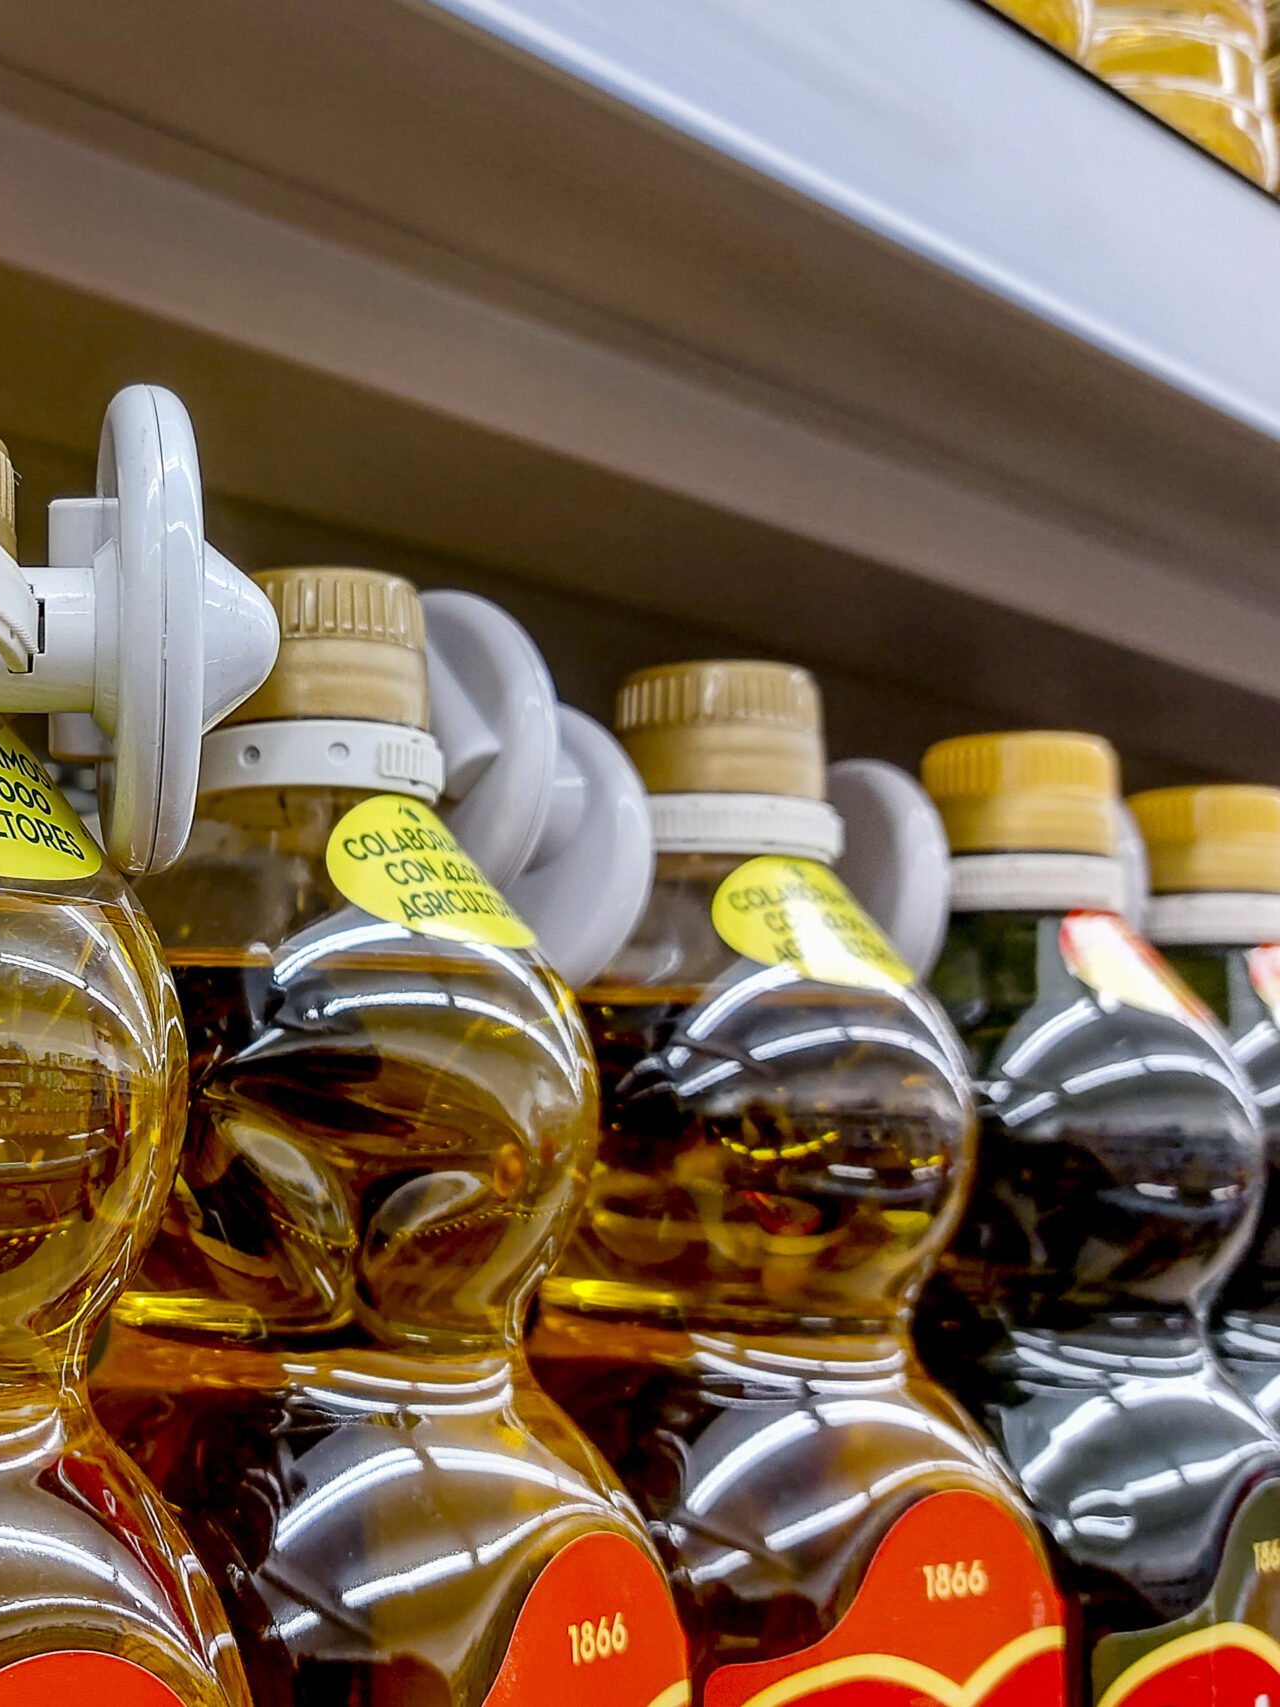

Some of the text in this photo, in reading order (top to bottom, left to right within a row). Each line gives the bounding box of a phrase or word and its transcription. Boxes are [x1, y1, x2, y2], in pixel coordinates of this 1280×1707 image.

[384, 856, 442, 886] CON
[1253, 1538, 1280, 1573] 186
[922, 1559, 988, 1601] 1866
[567, 1611, 628, 1666] 1866
